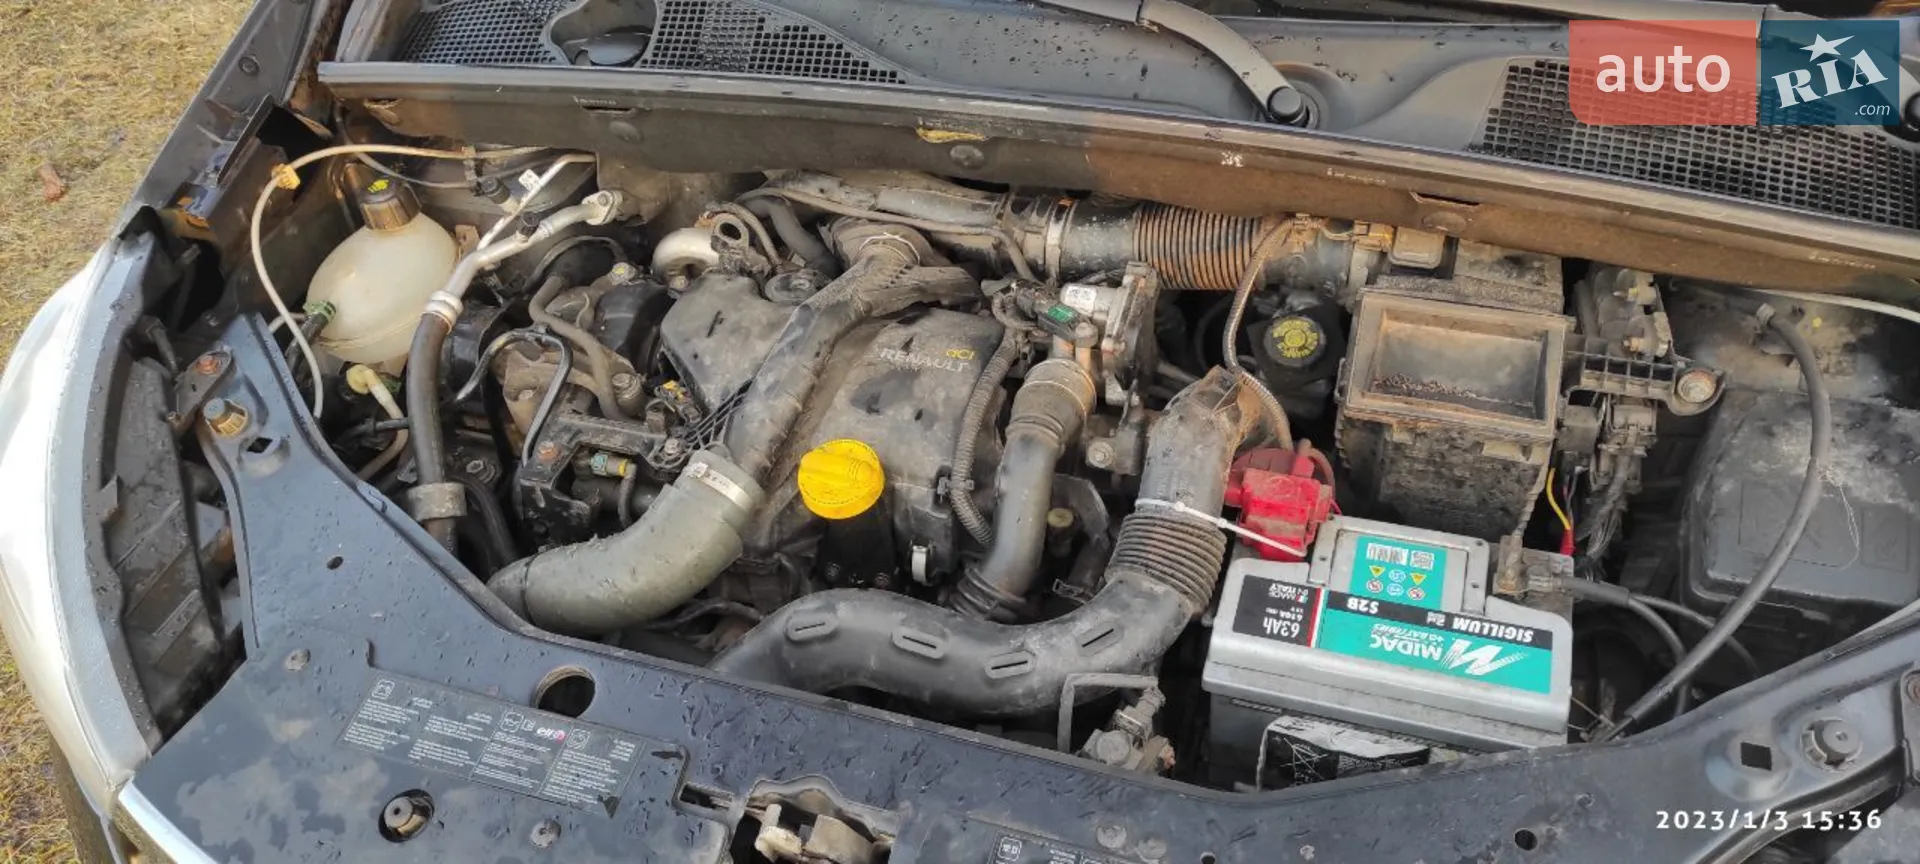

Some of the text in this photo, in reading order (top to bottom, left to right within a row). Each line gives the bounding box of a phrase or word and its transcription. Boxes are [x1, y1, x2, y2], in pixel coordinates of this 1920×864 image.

[880, 347, 969, 372] RENAULT
[1268, 583, 1296, 595] ITALY
[1346, 597, 1379, 614] S2B
[1263, 616, 1301, 638] 63Ah
[1452, 616, 1534, 643] SIGILLUM
[1368, 634, 1443, 661] MIDAC
